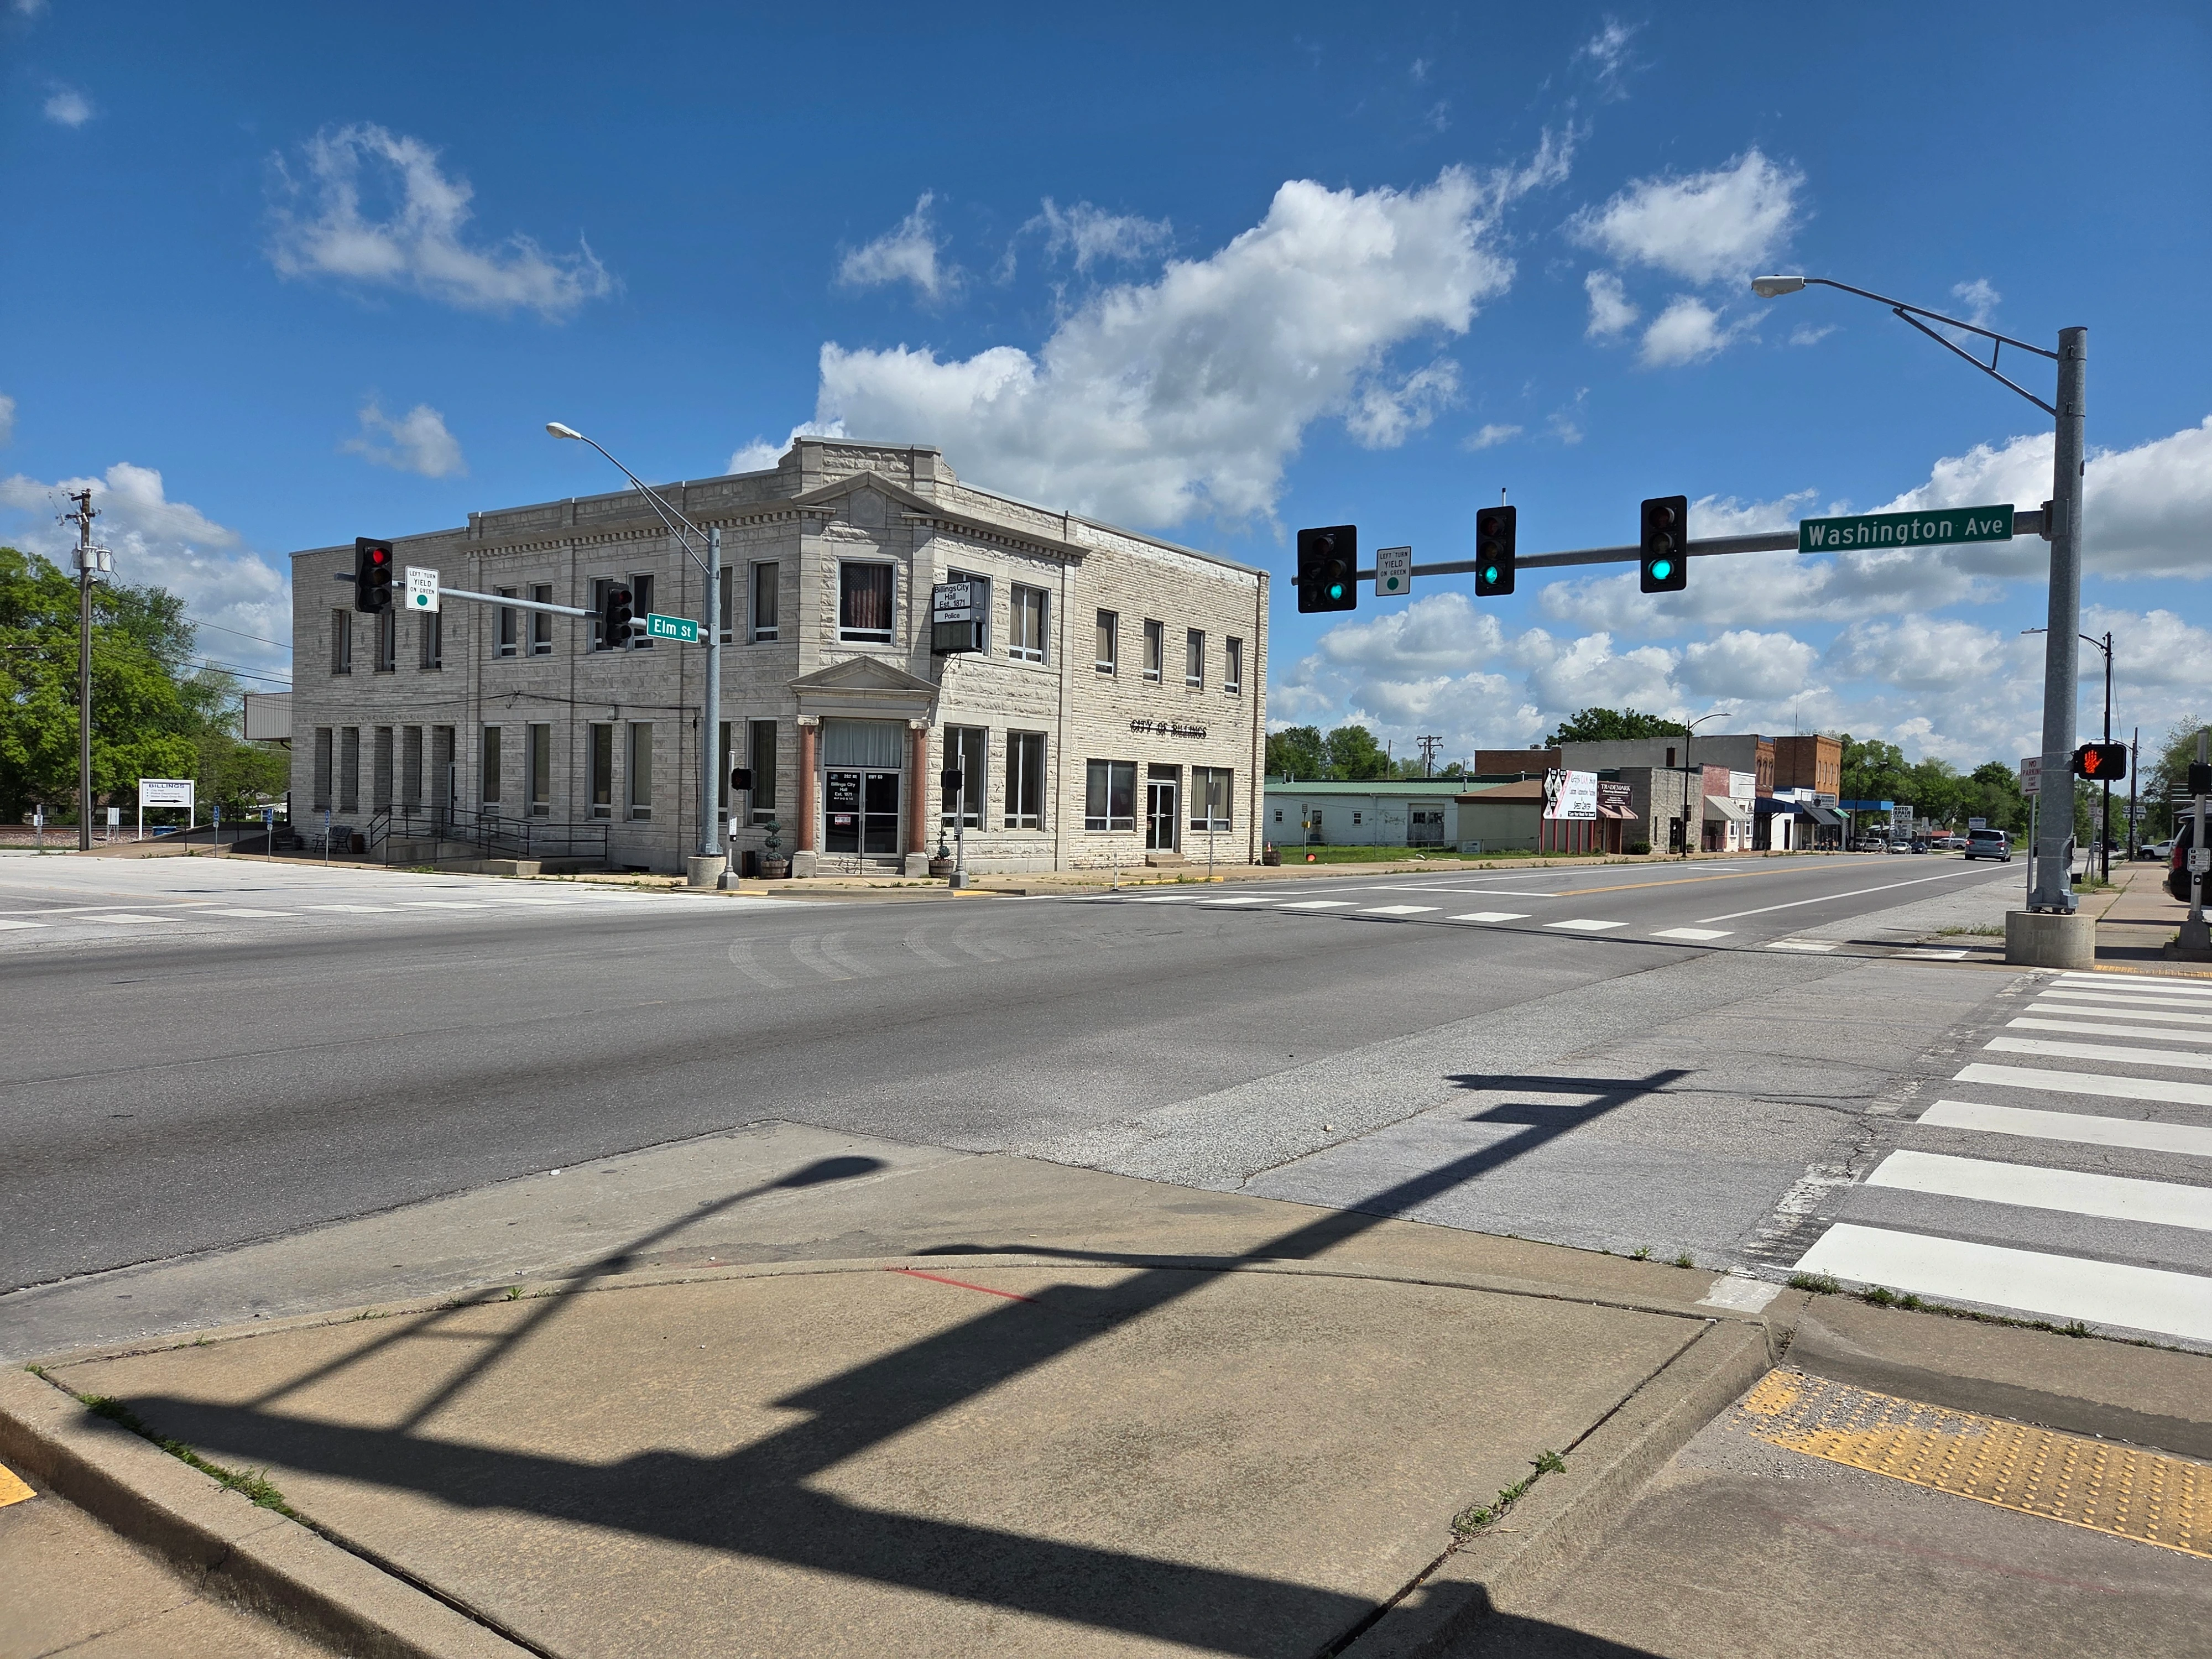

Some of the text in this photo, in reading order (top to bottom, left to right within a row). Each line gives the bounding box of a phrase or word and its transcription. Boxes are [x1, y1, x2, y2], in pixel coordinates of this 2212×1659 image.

[1809, 518, 2002, 546] Washington Ave
[414, 578, 431, 587] YIELD
[957, 584, 969, 592] City
[654, 619, 691, 637] Elm St
[1130, 719, 1207, 739] CITY OF BILLINGS
